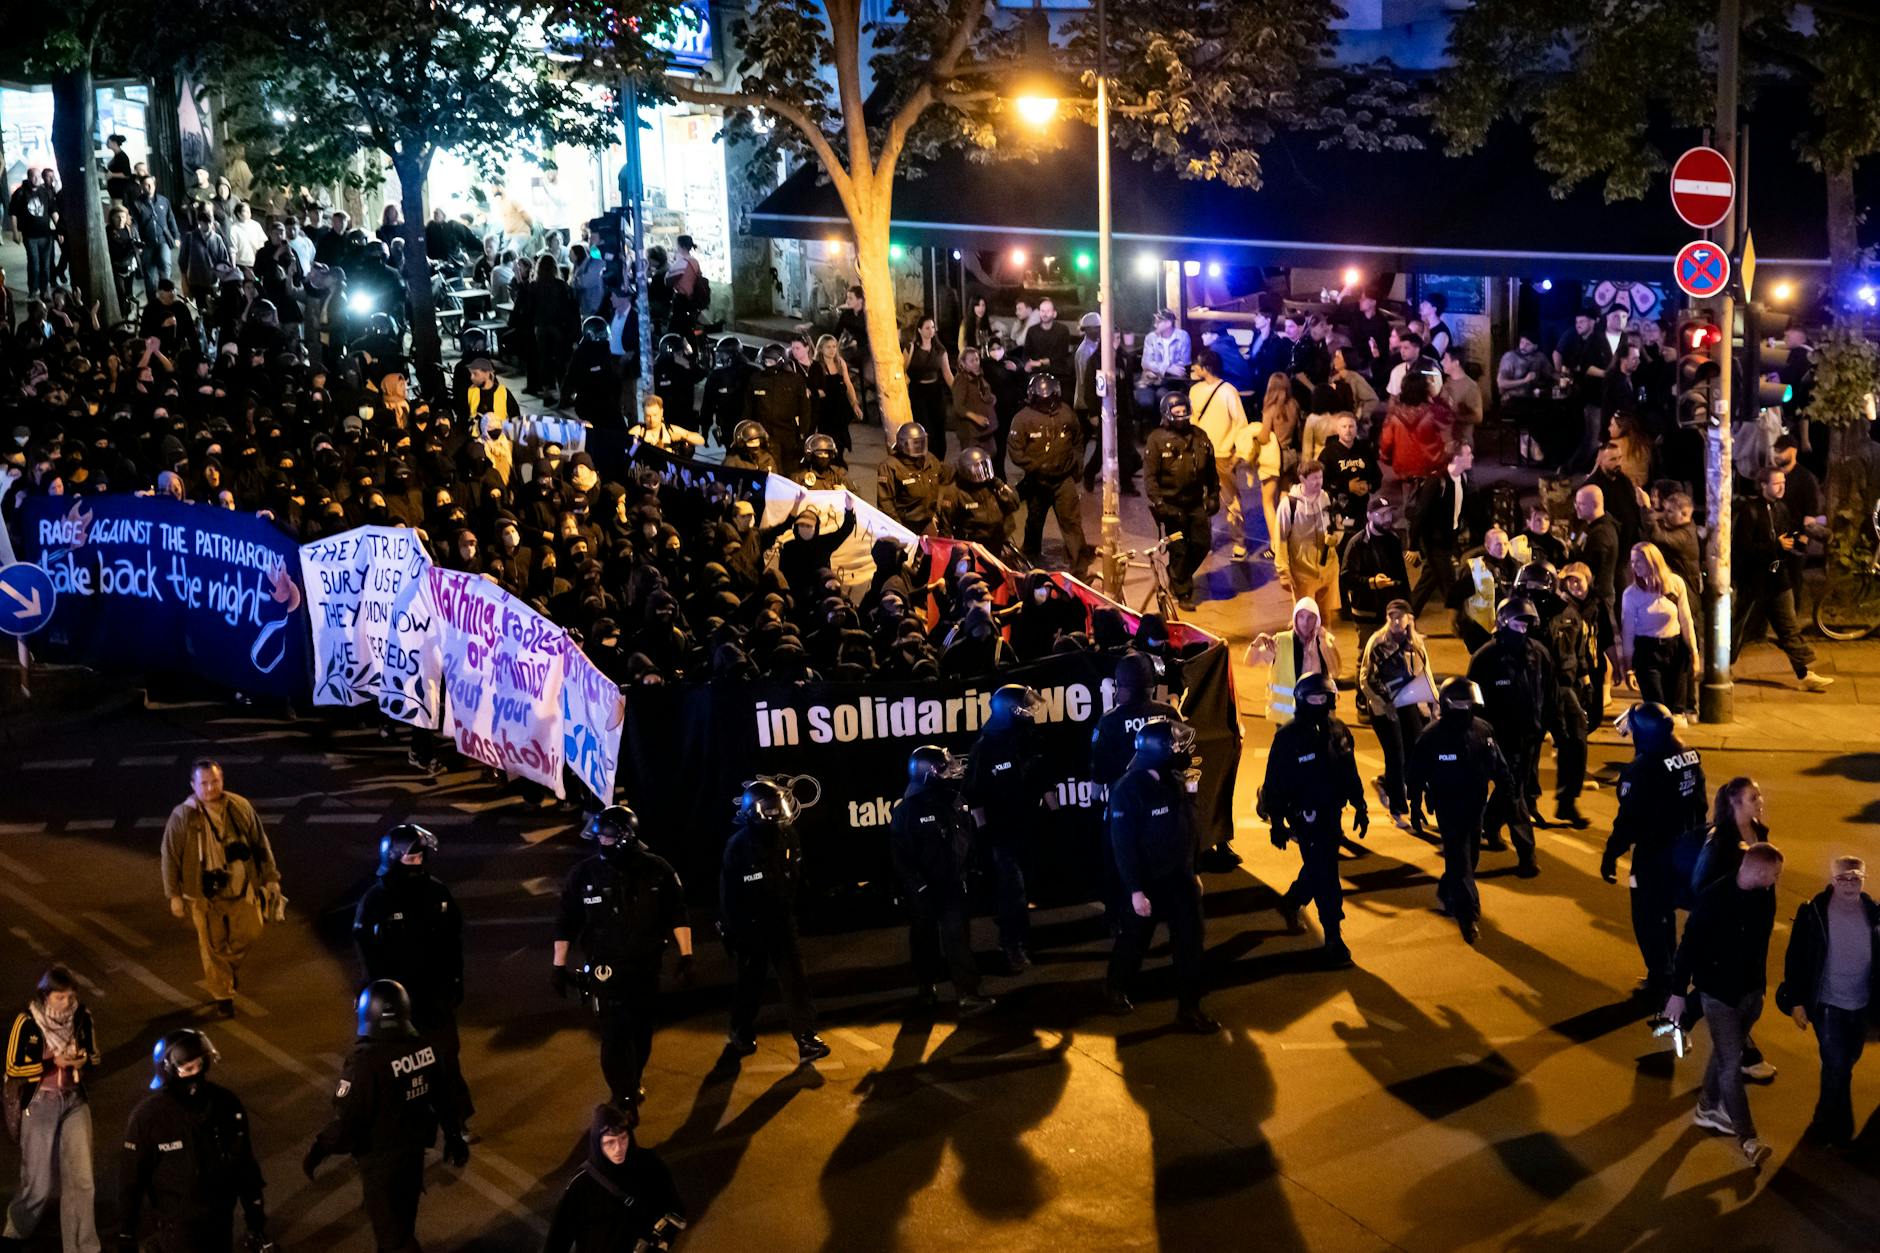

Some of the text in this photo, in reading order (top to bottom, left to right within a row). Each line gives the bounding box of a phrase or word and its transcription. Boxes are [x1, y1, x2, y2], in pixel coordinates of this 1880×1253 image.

[39, 518, 285, 574] RAGE AGAINST THE PATRIARCHY
[306, 534, 364, 562] THEY
[41, 548, 272, 628] take back the night
[320, 565, 371, 596] BURY
[318, 600, 362, 628] THEY
[430, 566, 496, 649] Nothing
[467, 641, 489, 672] or
[492, 693, 532, 735] your
[755, 700, 800, 748] in
[807, 687, 993, 745] solidarit
[1032, 683, 1093, 726] we
[1438, 753, 1458, 762] POLIZEI
[1663, 749, 1700, 773] POLIZEI
[743, 870, 764, 883] POLIZEI
[391, 1045, 437, 1078] POLIZEI
[411, 1074, 425, 1089] BE
[158, 1139, 184, 1153] POLIZEI
